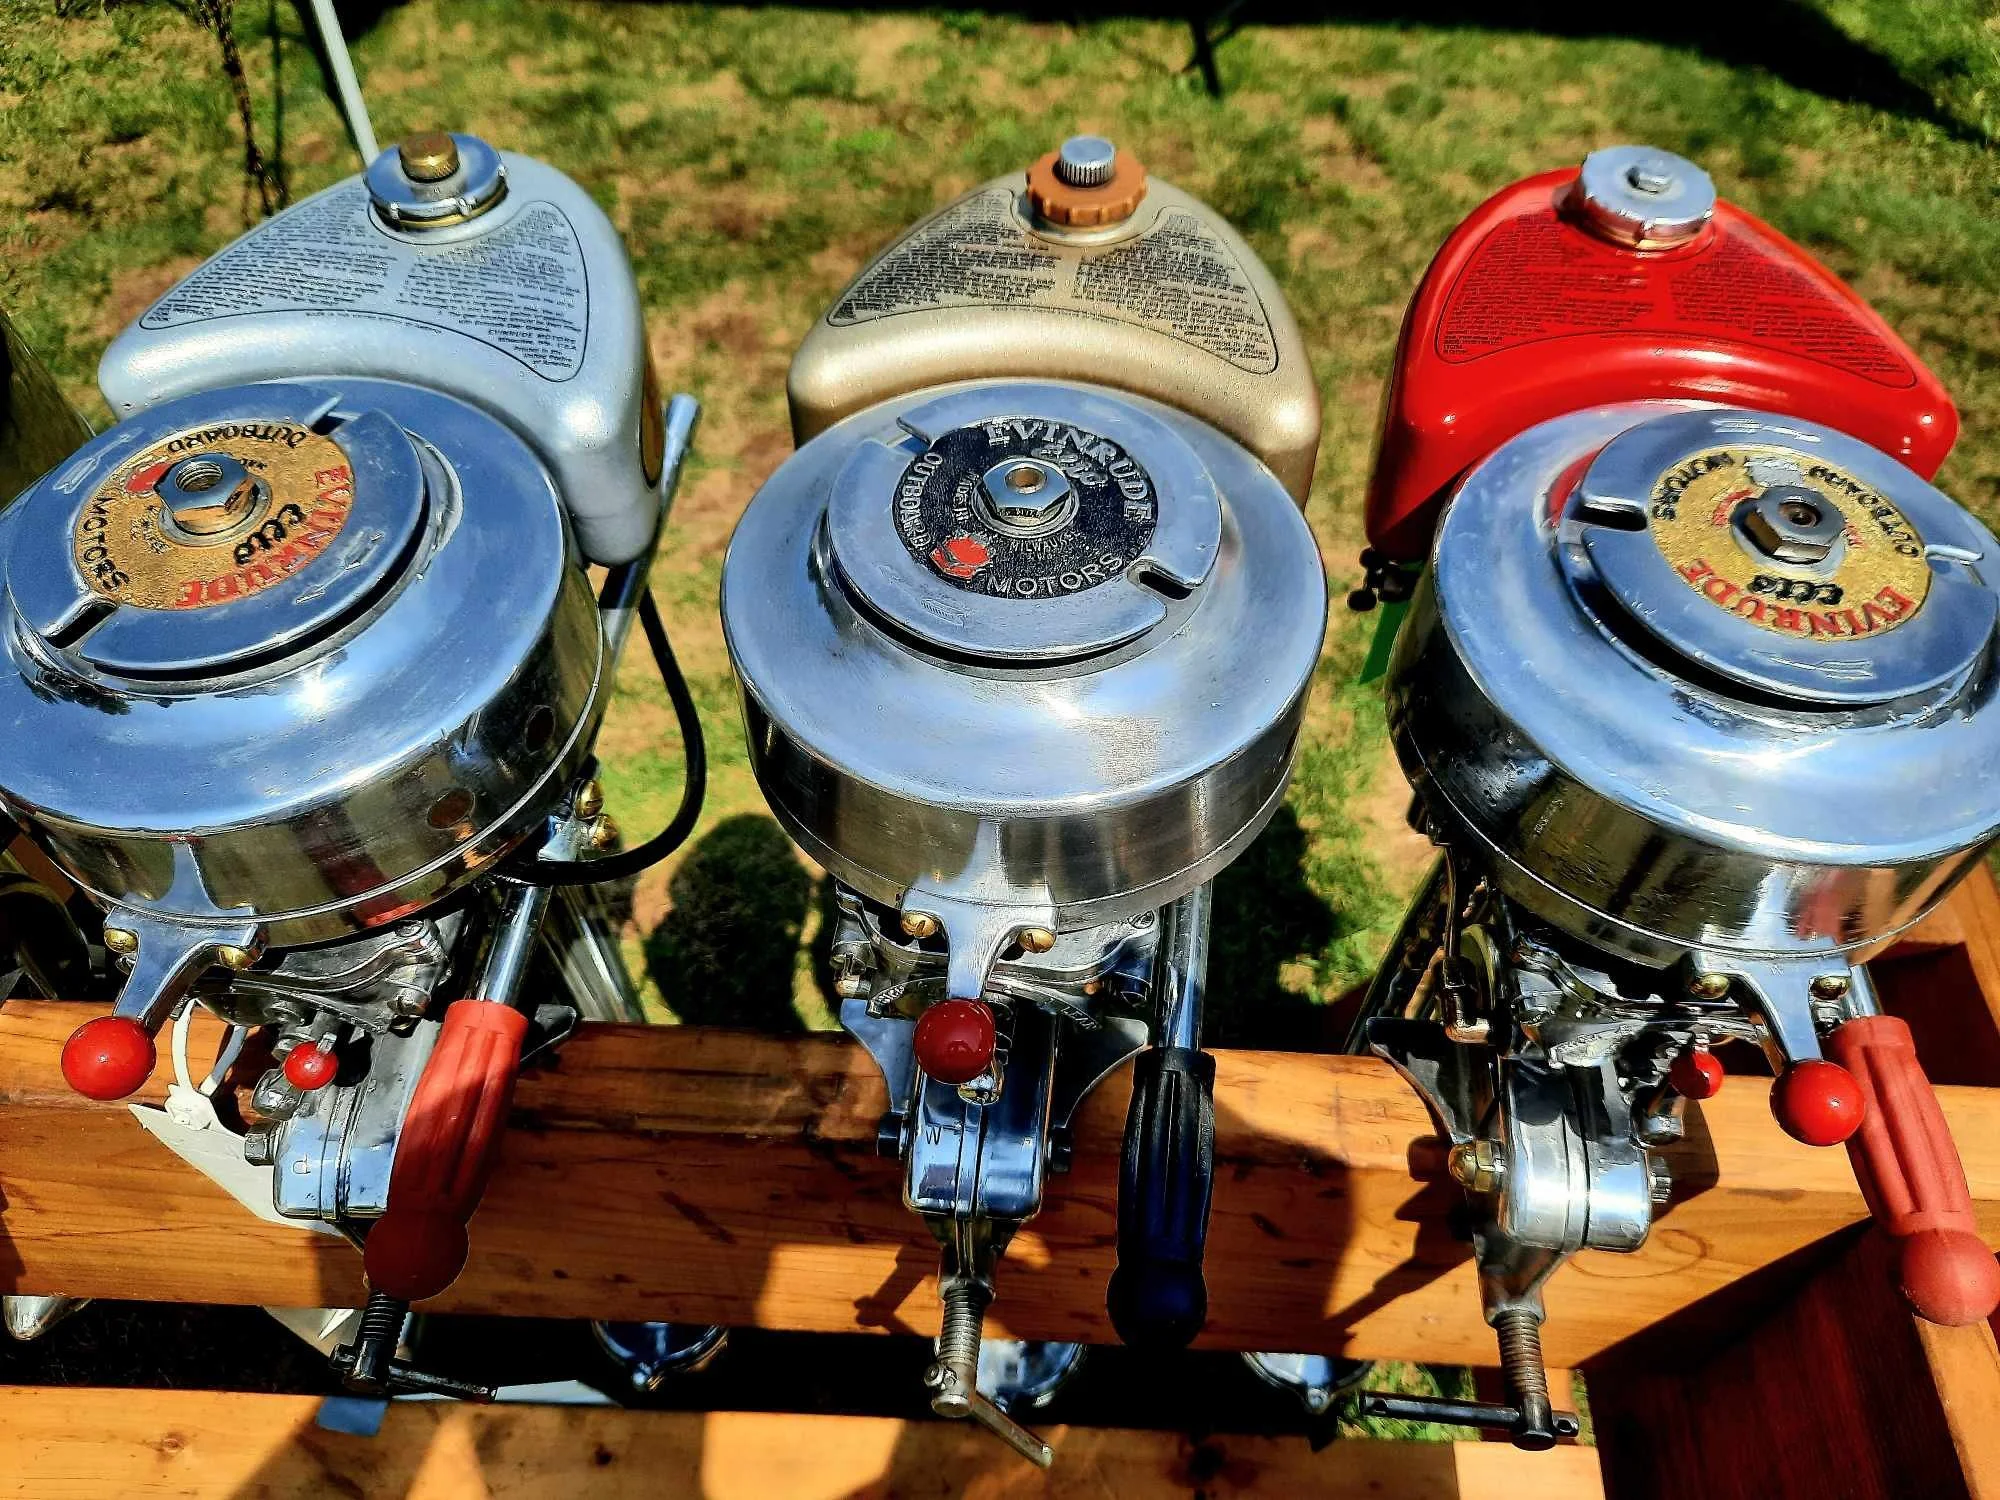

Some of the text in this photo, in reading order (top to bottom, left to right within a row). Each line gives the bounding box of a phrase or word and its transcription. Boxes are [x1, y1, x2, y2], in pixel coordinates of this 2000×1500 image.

[168, 422, 307, 450] OUTBOARD
[982, 417, 1153, 522] EVINRUDE
[82, 495, 130, 591] MOTORS
[174, 464, 352, 609] EVINRUDE
[898, 451, 944, 552] OUTBOARD
[986, 550, 1124, 597] MOTORS
[1676, 556, 1916, 637] EVINRUDE
